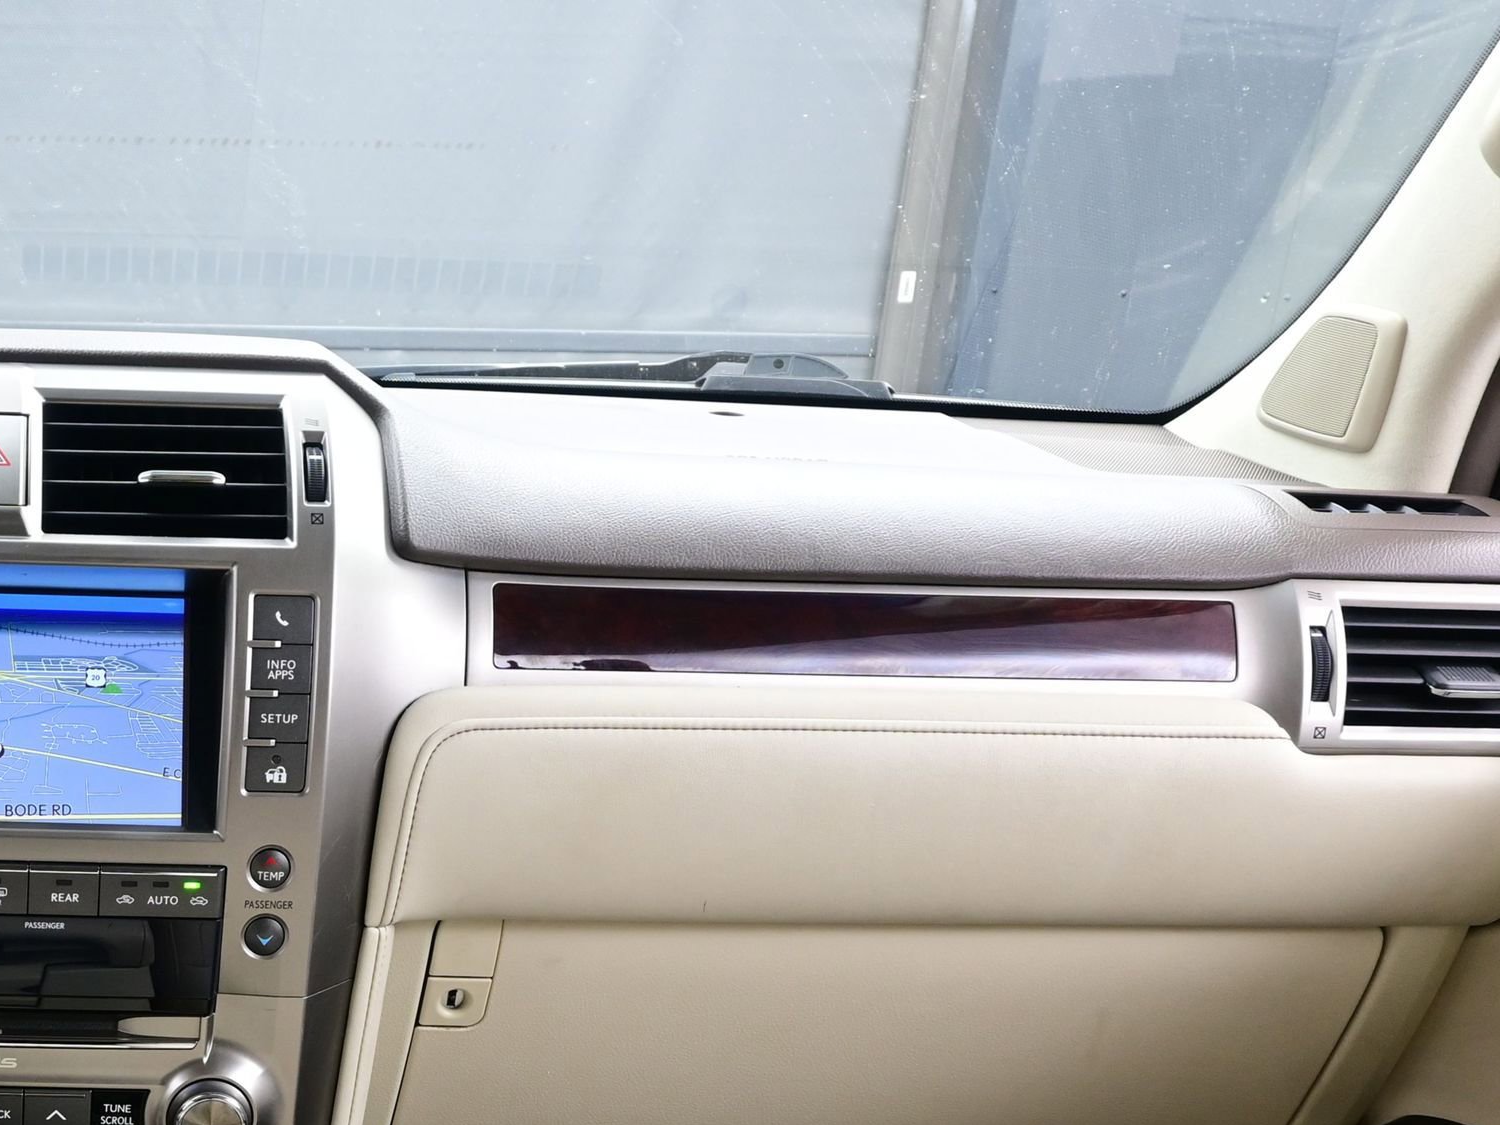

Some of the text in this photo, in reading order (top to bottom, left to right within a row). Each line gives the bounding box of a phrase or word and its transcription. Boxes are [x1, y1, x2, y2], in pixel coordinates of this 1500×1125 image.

[267, 659, 297, 670] INFO
[267, 669, 295, 680] APPS
[260, 713, 299, 724] SETUP
[4, 803, 72, 817] BODE RD
[257, 870, 285, 882] TEMP
[50, 892, 80, 904] REAR
[146, 895, 179, 906] AUTO
[244, 899, 294, 911] PASSENGER
[24, 921, 66, 930] PASSENGER
[103, 1103, 132, 1114] TUNE
[100, 1115, 135, 1125] SCROLL
